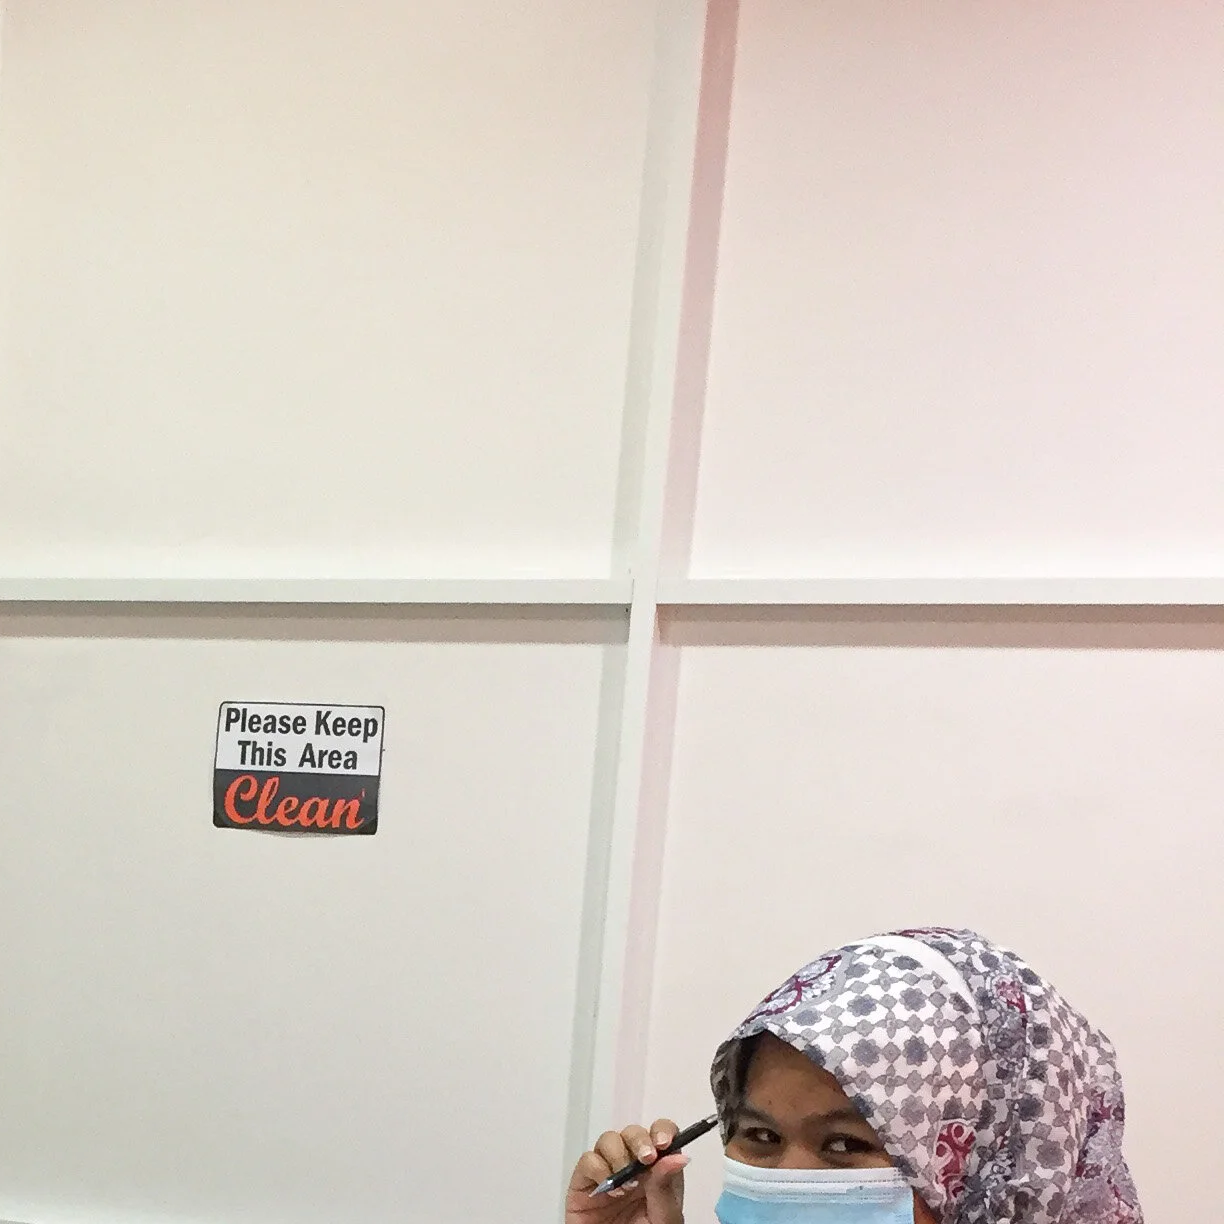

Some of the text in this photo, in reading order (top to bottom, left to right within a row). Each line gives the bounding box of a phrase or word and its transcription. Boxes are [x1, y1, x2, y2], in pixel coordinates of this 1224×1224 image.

[224, 707, 379, 743] Please Keep
[237, 740, 358, 770] This Area
[224, 774, 365, 829] Clean
